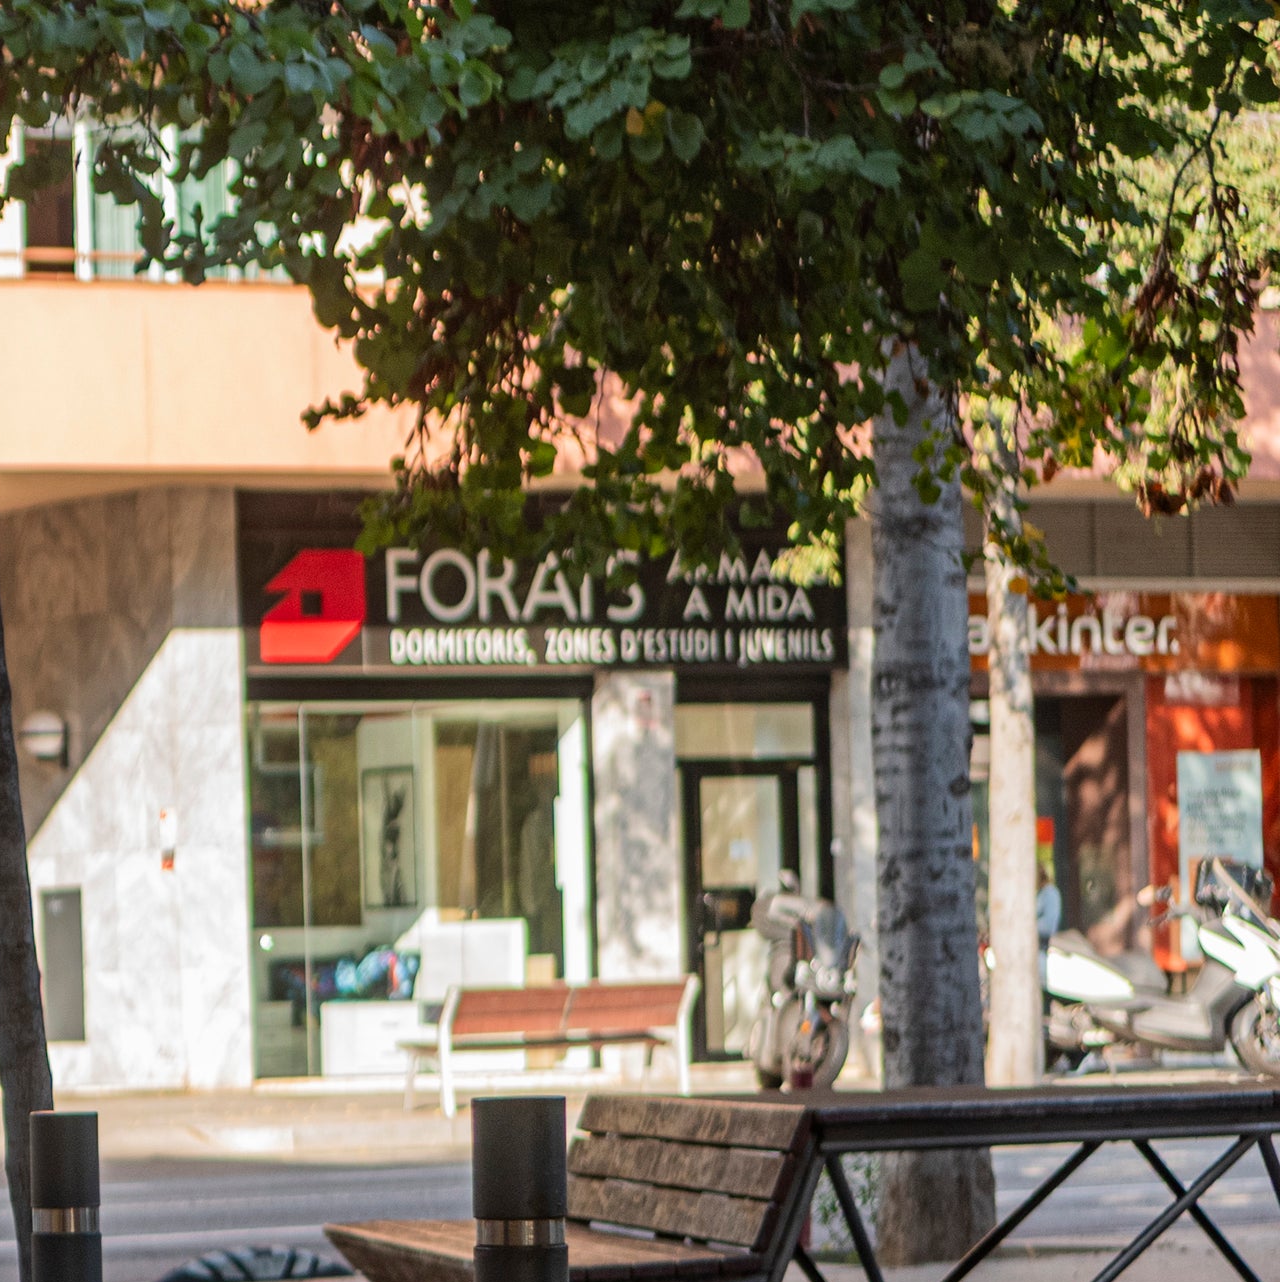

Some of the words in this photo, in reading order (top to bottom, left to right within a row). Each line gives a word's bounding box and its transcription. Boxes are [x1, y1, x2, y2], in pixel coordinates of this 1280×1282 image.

[682, 584, 713, 623] A
[724, 584, 816, 623] MIDA
[544, 627, 617, 665] ZONES
[619, 627, 719, 664] D'ESTUDI
[724, 627, 735, 663] I
[737, 627, 835, 669] JUVENILS
